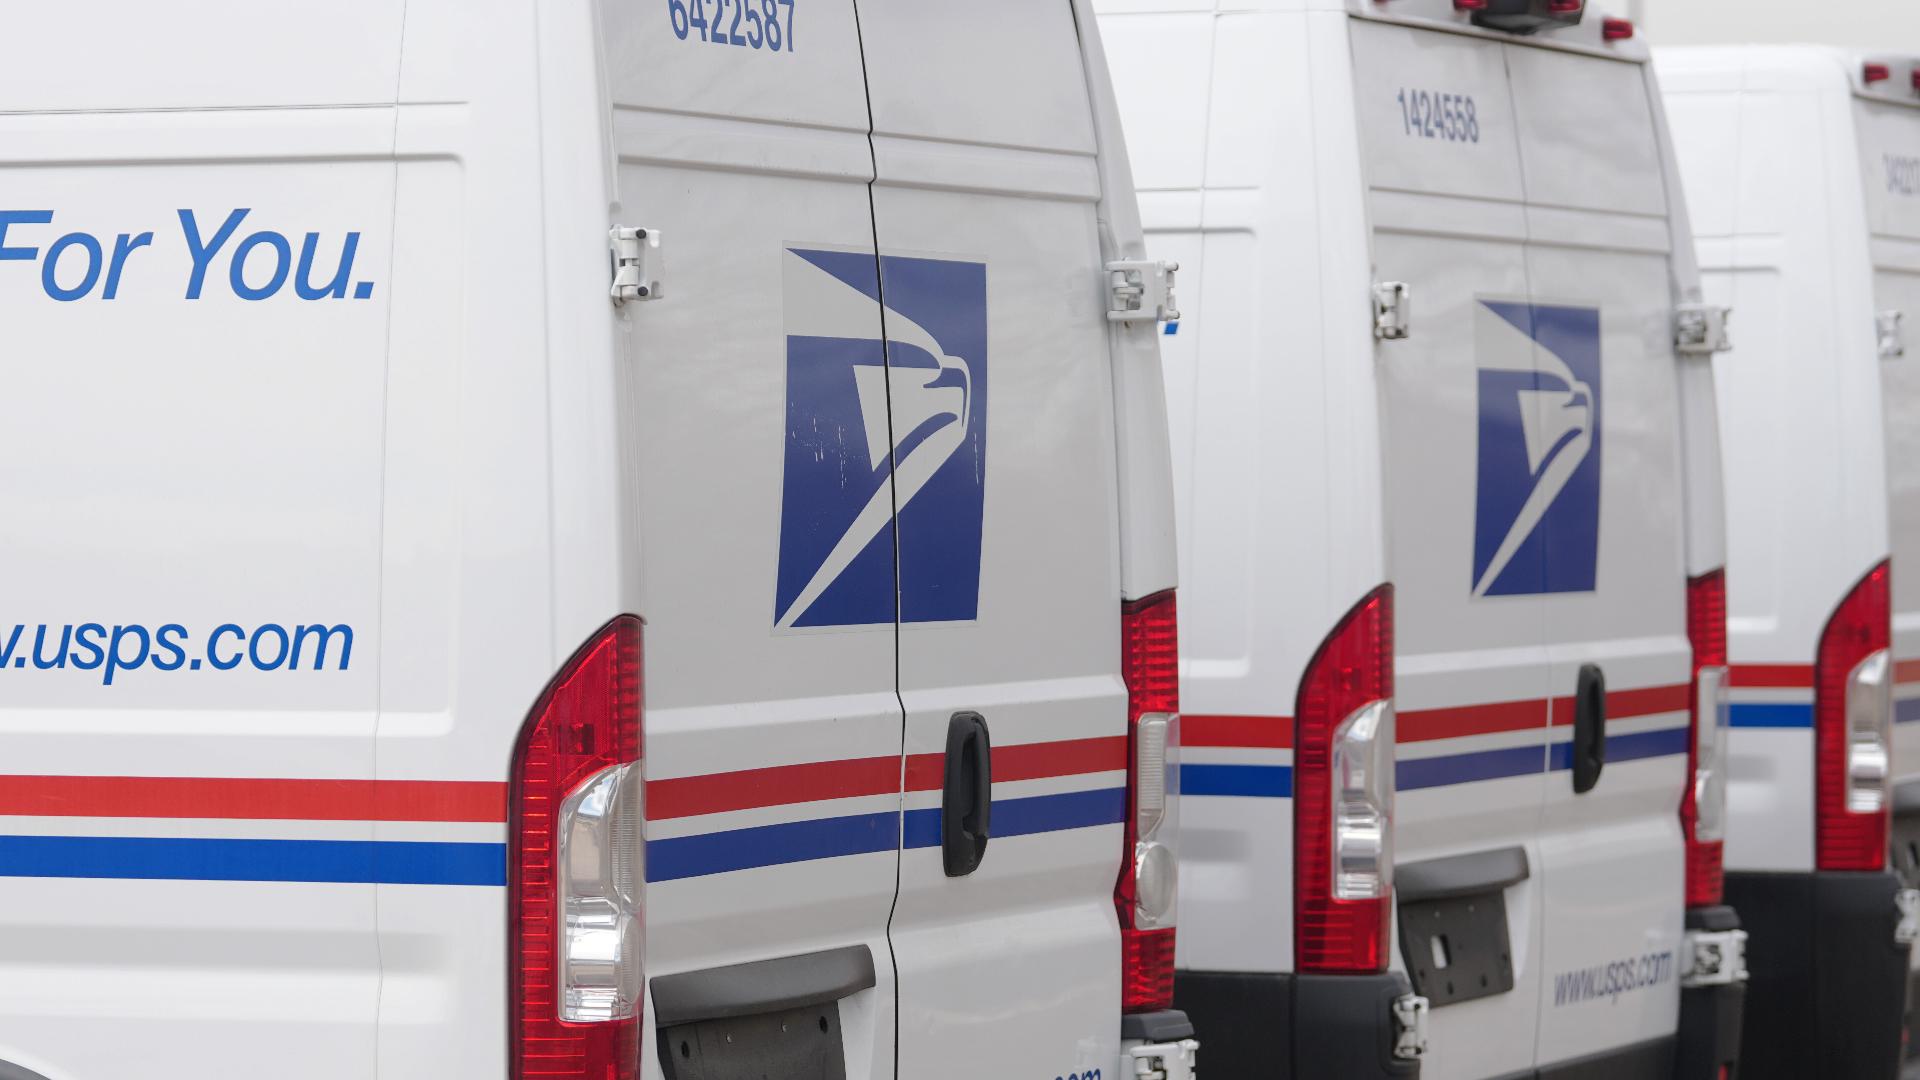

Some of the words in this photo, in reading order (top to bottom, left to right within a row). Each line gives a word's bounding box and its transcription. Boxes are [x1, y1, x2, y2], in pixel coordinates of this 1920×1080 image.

[668, 0, 795, 52] 6422587
[1397, 87, 1479, 143] 1424558
[0, 209, 154, 302] For
[177, 207, 374, 302] You.
[1554, 950, 1671, 1006] www.usps.com
